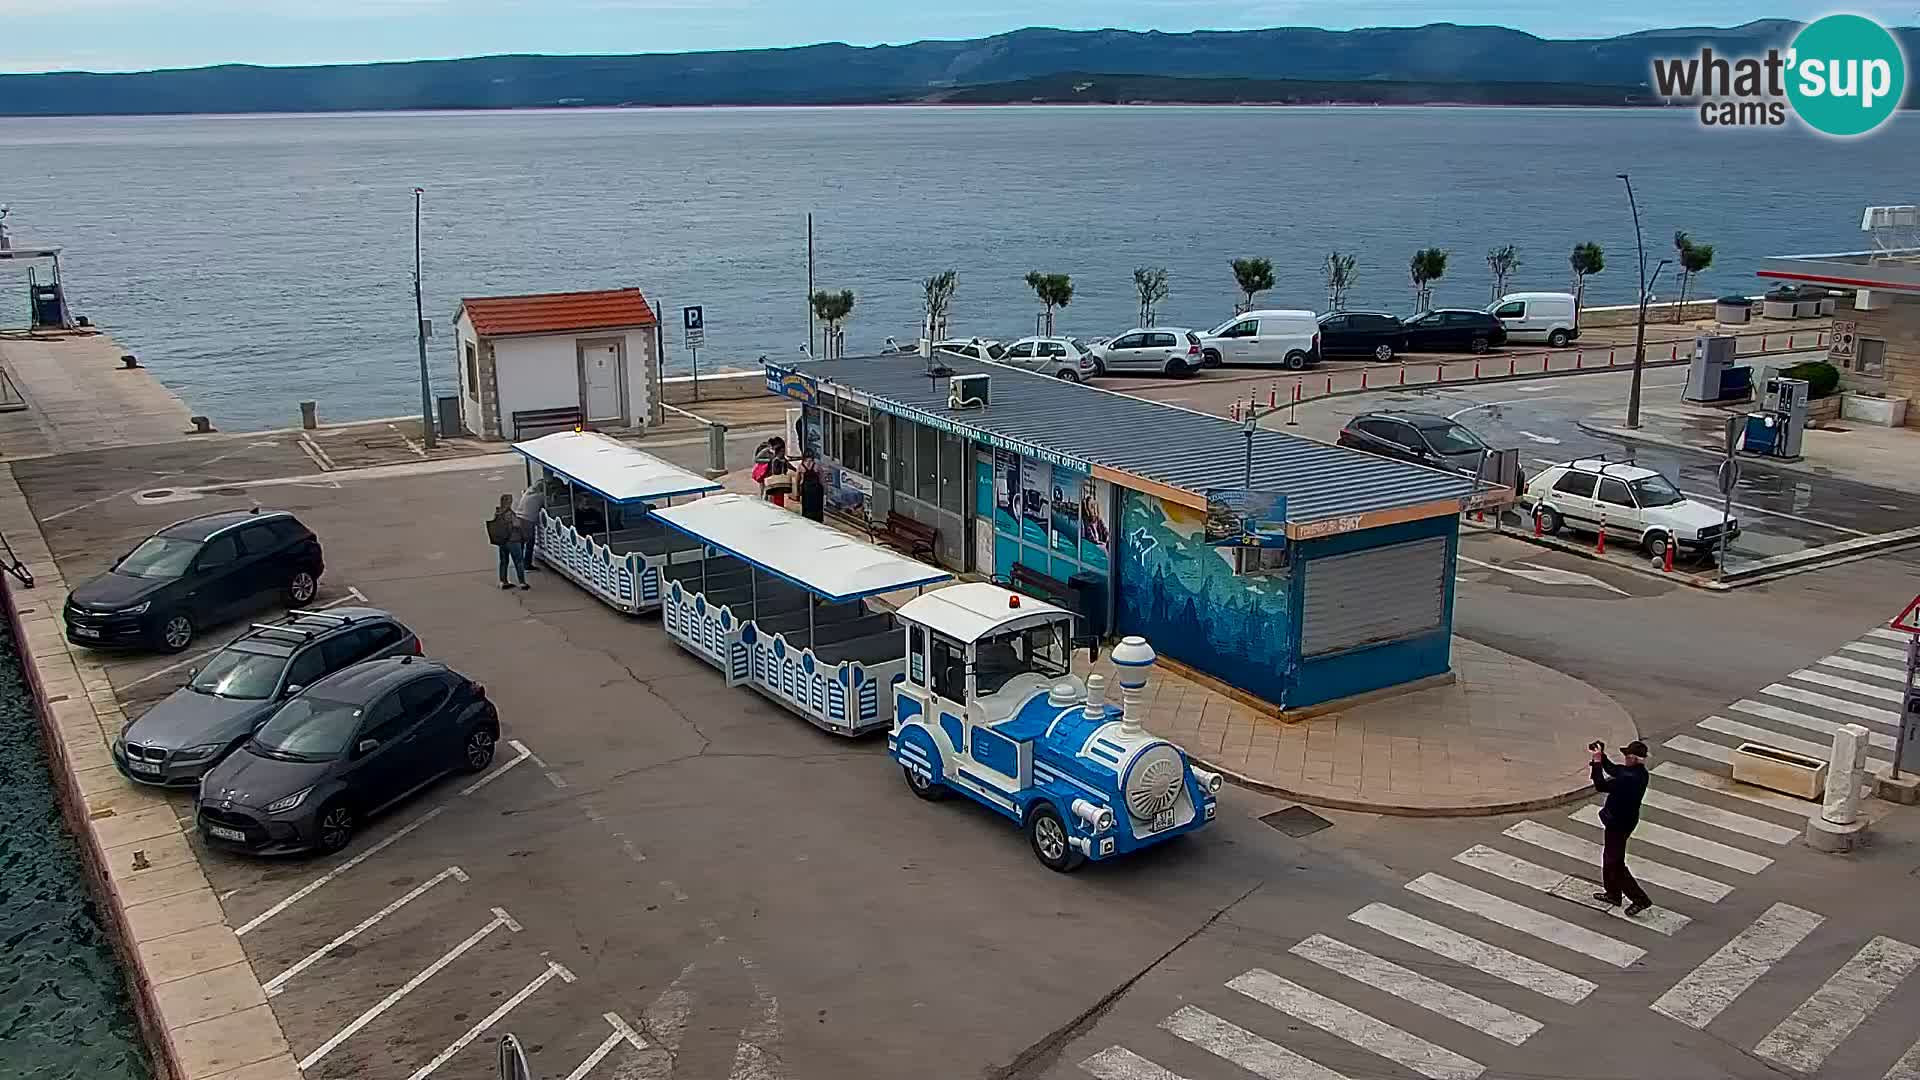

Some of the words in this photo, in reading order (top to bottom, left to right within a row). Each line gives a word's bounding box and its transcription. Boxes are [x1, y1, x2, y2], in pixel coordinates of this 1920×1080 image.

[688, 309, 699, 326] P
[952, 423, 980, 440] POSTAJA
[990, 435, 1004, 448] BUS
[1005, 439, 1035, 457] STATION
[1036, 449, 1060, 465] TICKET
[1062, 457, 1087, 472] OFFICE
